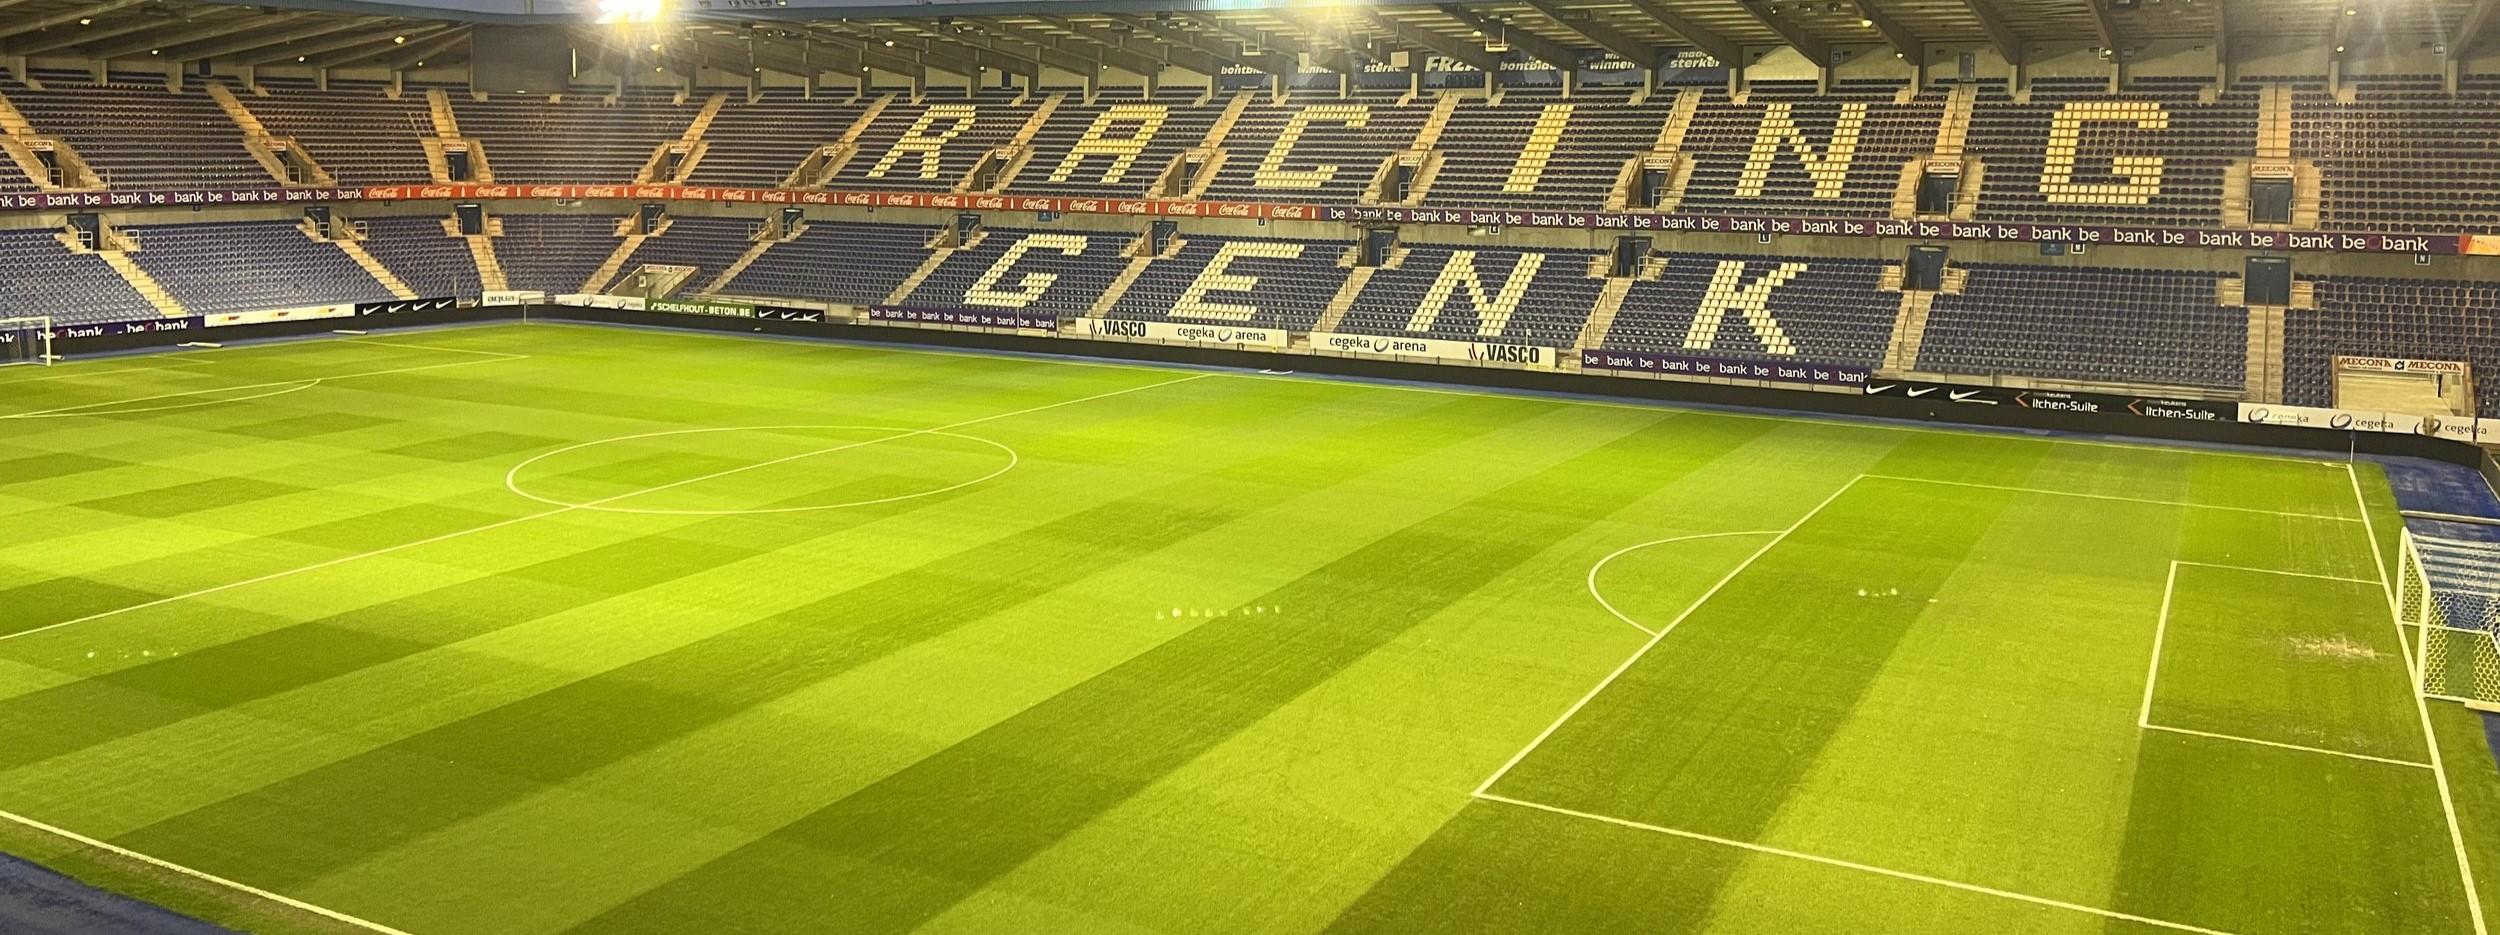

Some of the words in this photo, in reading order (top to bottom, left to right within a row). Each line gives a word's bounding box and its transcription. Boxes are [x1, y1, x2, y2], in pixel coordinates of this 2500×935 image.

[19, 195, 35, 207] be
[47, 193, 79, 206] bank
[85, 193, 100, 205] be
[111, 192, 141, 204] bank
[150, 192, 165, 204] be
[175, 190, 203, 203] bank
[208, 191, 223, 202] be
[232, 190, 259, 201] bank
[264, 190, 277, 201] be
[286, 189, 312, 200] bank
[316, 188, 330, 200] be
[338, 188, 362, 200] bank
[1330, 207, 1345, 220] be
[1354, 208, 1382, 219] bank
[1387, 209, 1402, 222] be
[1411, 210, 1440, 223] bank
[1445, 211, 1460, 223] be
[1470, 211, 1500, 225] bank
[1505, 212, 1522, 225] be
[1532, 213, 1563, 226] bank
[1568, 213, 1585, 226] be
[1596, 214, 1628, 227] bank
[1633, 216, 1650, 228] be
[1662, 217, 1695, 229] bank
[1701, 217, 1719, 230] be
[1731, 218, 1765, 231] bank
[1771, 220, 1790, 232] be
[1802, 221, 1838, 234] bank
[1845, 221, 1864, 234] be
[1876, 222, 1913, 235] bank
[1920, 223, 1940, 237] be
[1953, 224, 1991, 238] bank
[1998, 225, 2019, 239] be
[2032, 227, 2072, 240] bank
[2079, 228, 2100, 242] be
[2114, 229, 2155, 244] bank
[2163, 230, 2185, 245] be
[2200, 232, 2242, 246] bank
[2251, 233, 2273, 247] be
[2289, 234, 2334, 249] bank
[2342, 236, 2365, 250] be
[2382, 237, 2429, 251] bank
[871, 308, 880, 317] be
[886, 309, 902, 318] bank
[907, 311, 917, 320] be
[922, 311, 940, 321] bank
[944, 313, 954, 322] be
[959, 314, 977, 323] bank
[981, 316, 991, 324] be
[997, 317, 1015, 326] bank
[1020, 318, 1030, 327] be
[1036, 319, 1054, 328] bank
[1103, 320, 1146, 337] VASCO
[1178, 326, 1215, 341] cegeka
[1235, 330, 1266, 341] arena
[1329, 336, 1370, 351] cegeka
[1393, 340, 1427, 352] arena
[1486, 344, 1540, 363] VASCO
[1585, 354, 1599, 365] be
[1607, 355, 1633, 367] bank
[1640, 357, 1654, 368] be
[1662, 359, 1689, 371] bank
[1696, 361, 1710, 372] be
[1719, 363, 1747, 375] bank
[1754, 365, 1769, 377] be
[1778, 367, 1807, 379] bank
[1814, 369, 1829, 380] be
[2340, 358, 2392, 367] MECONA
[2408, 361, 2461, 370] MECONA
